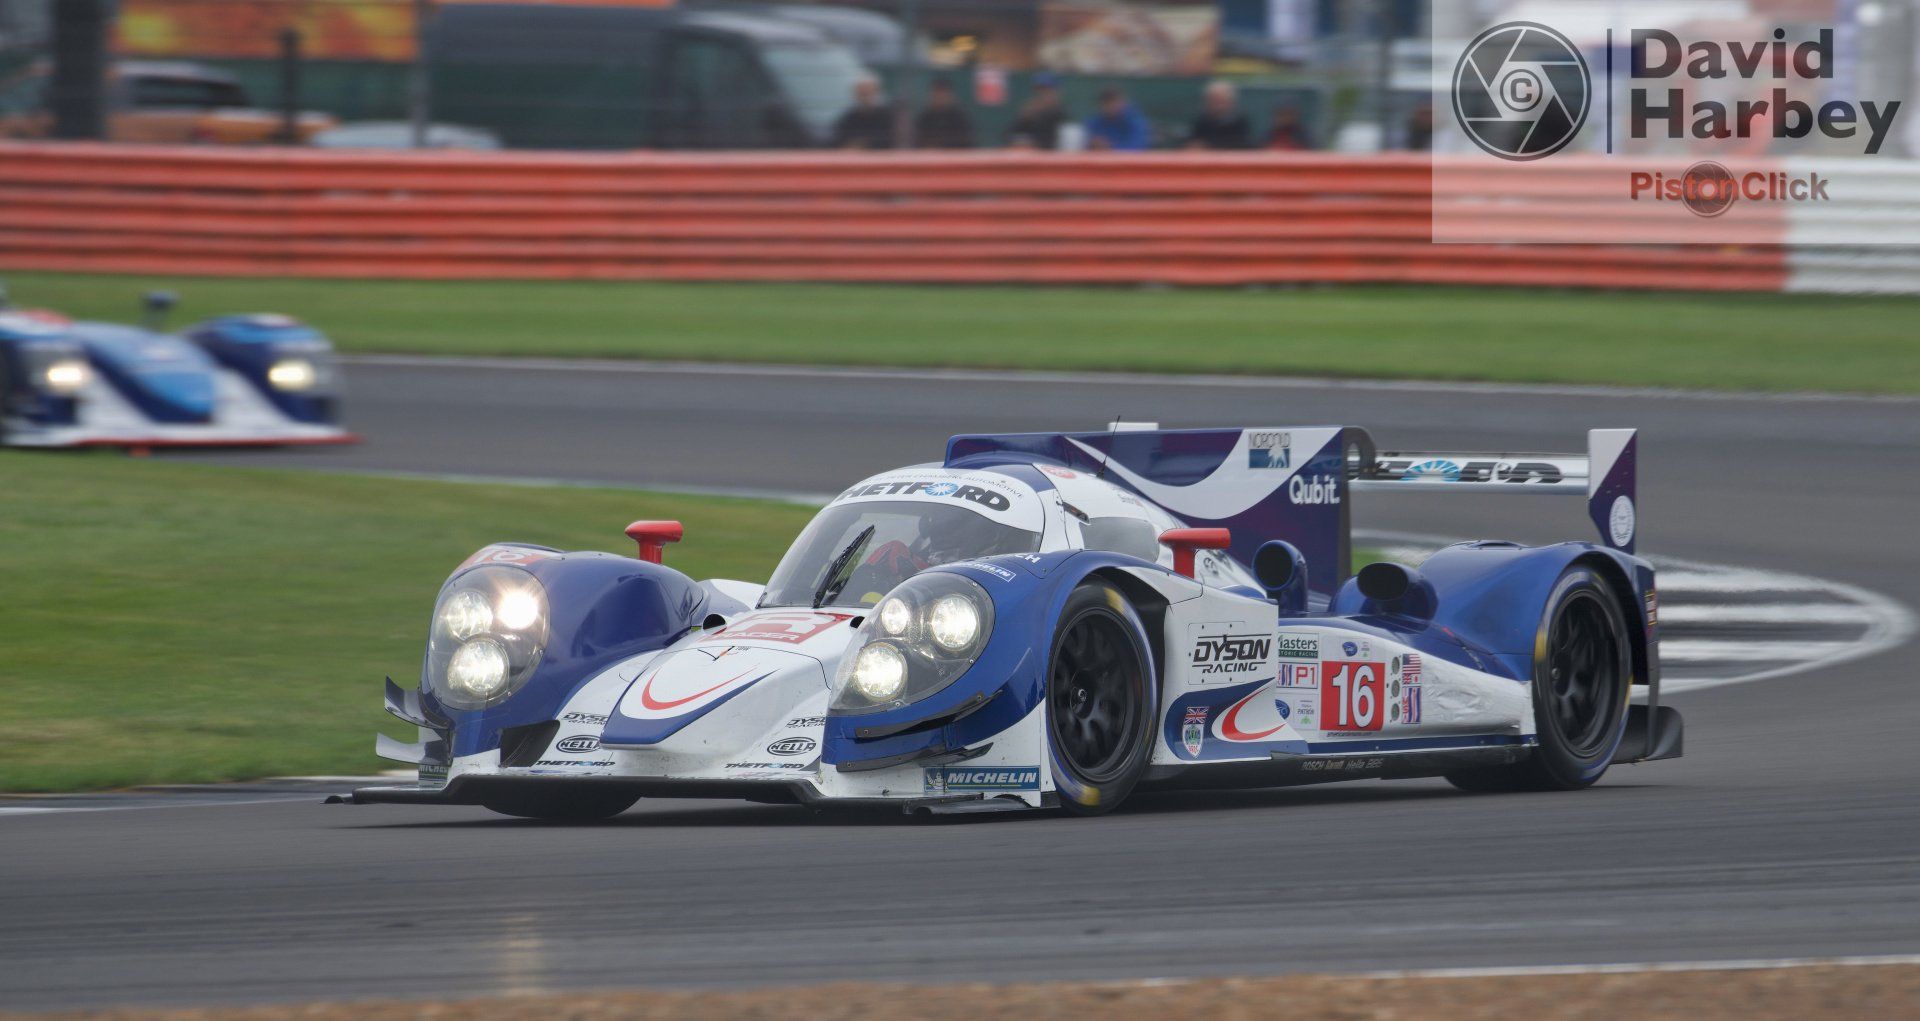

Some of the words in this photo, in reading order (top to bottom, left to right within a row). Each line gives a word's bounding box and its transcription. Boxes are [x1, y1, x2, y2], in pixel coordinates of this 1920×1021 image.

[1193, 638, 1271, 662] DYSON
[1192, 662, 1266, 673] RACING
[1295, 667, 1315, 685] P1
[1332, 664, 1375, 728] 16
[770, 743, 817, 752] HELLA
[947, 772, 1037, 784] MICHELIN
